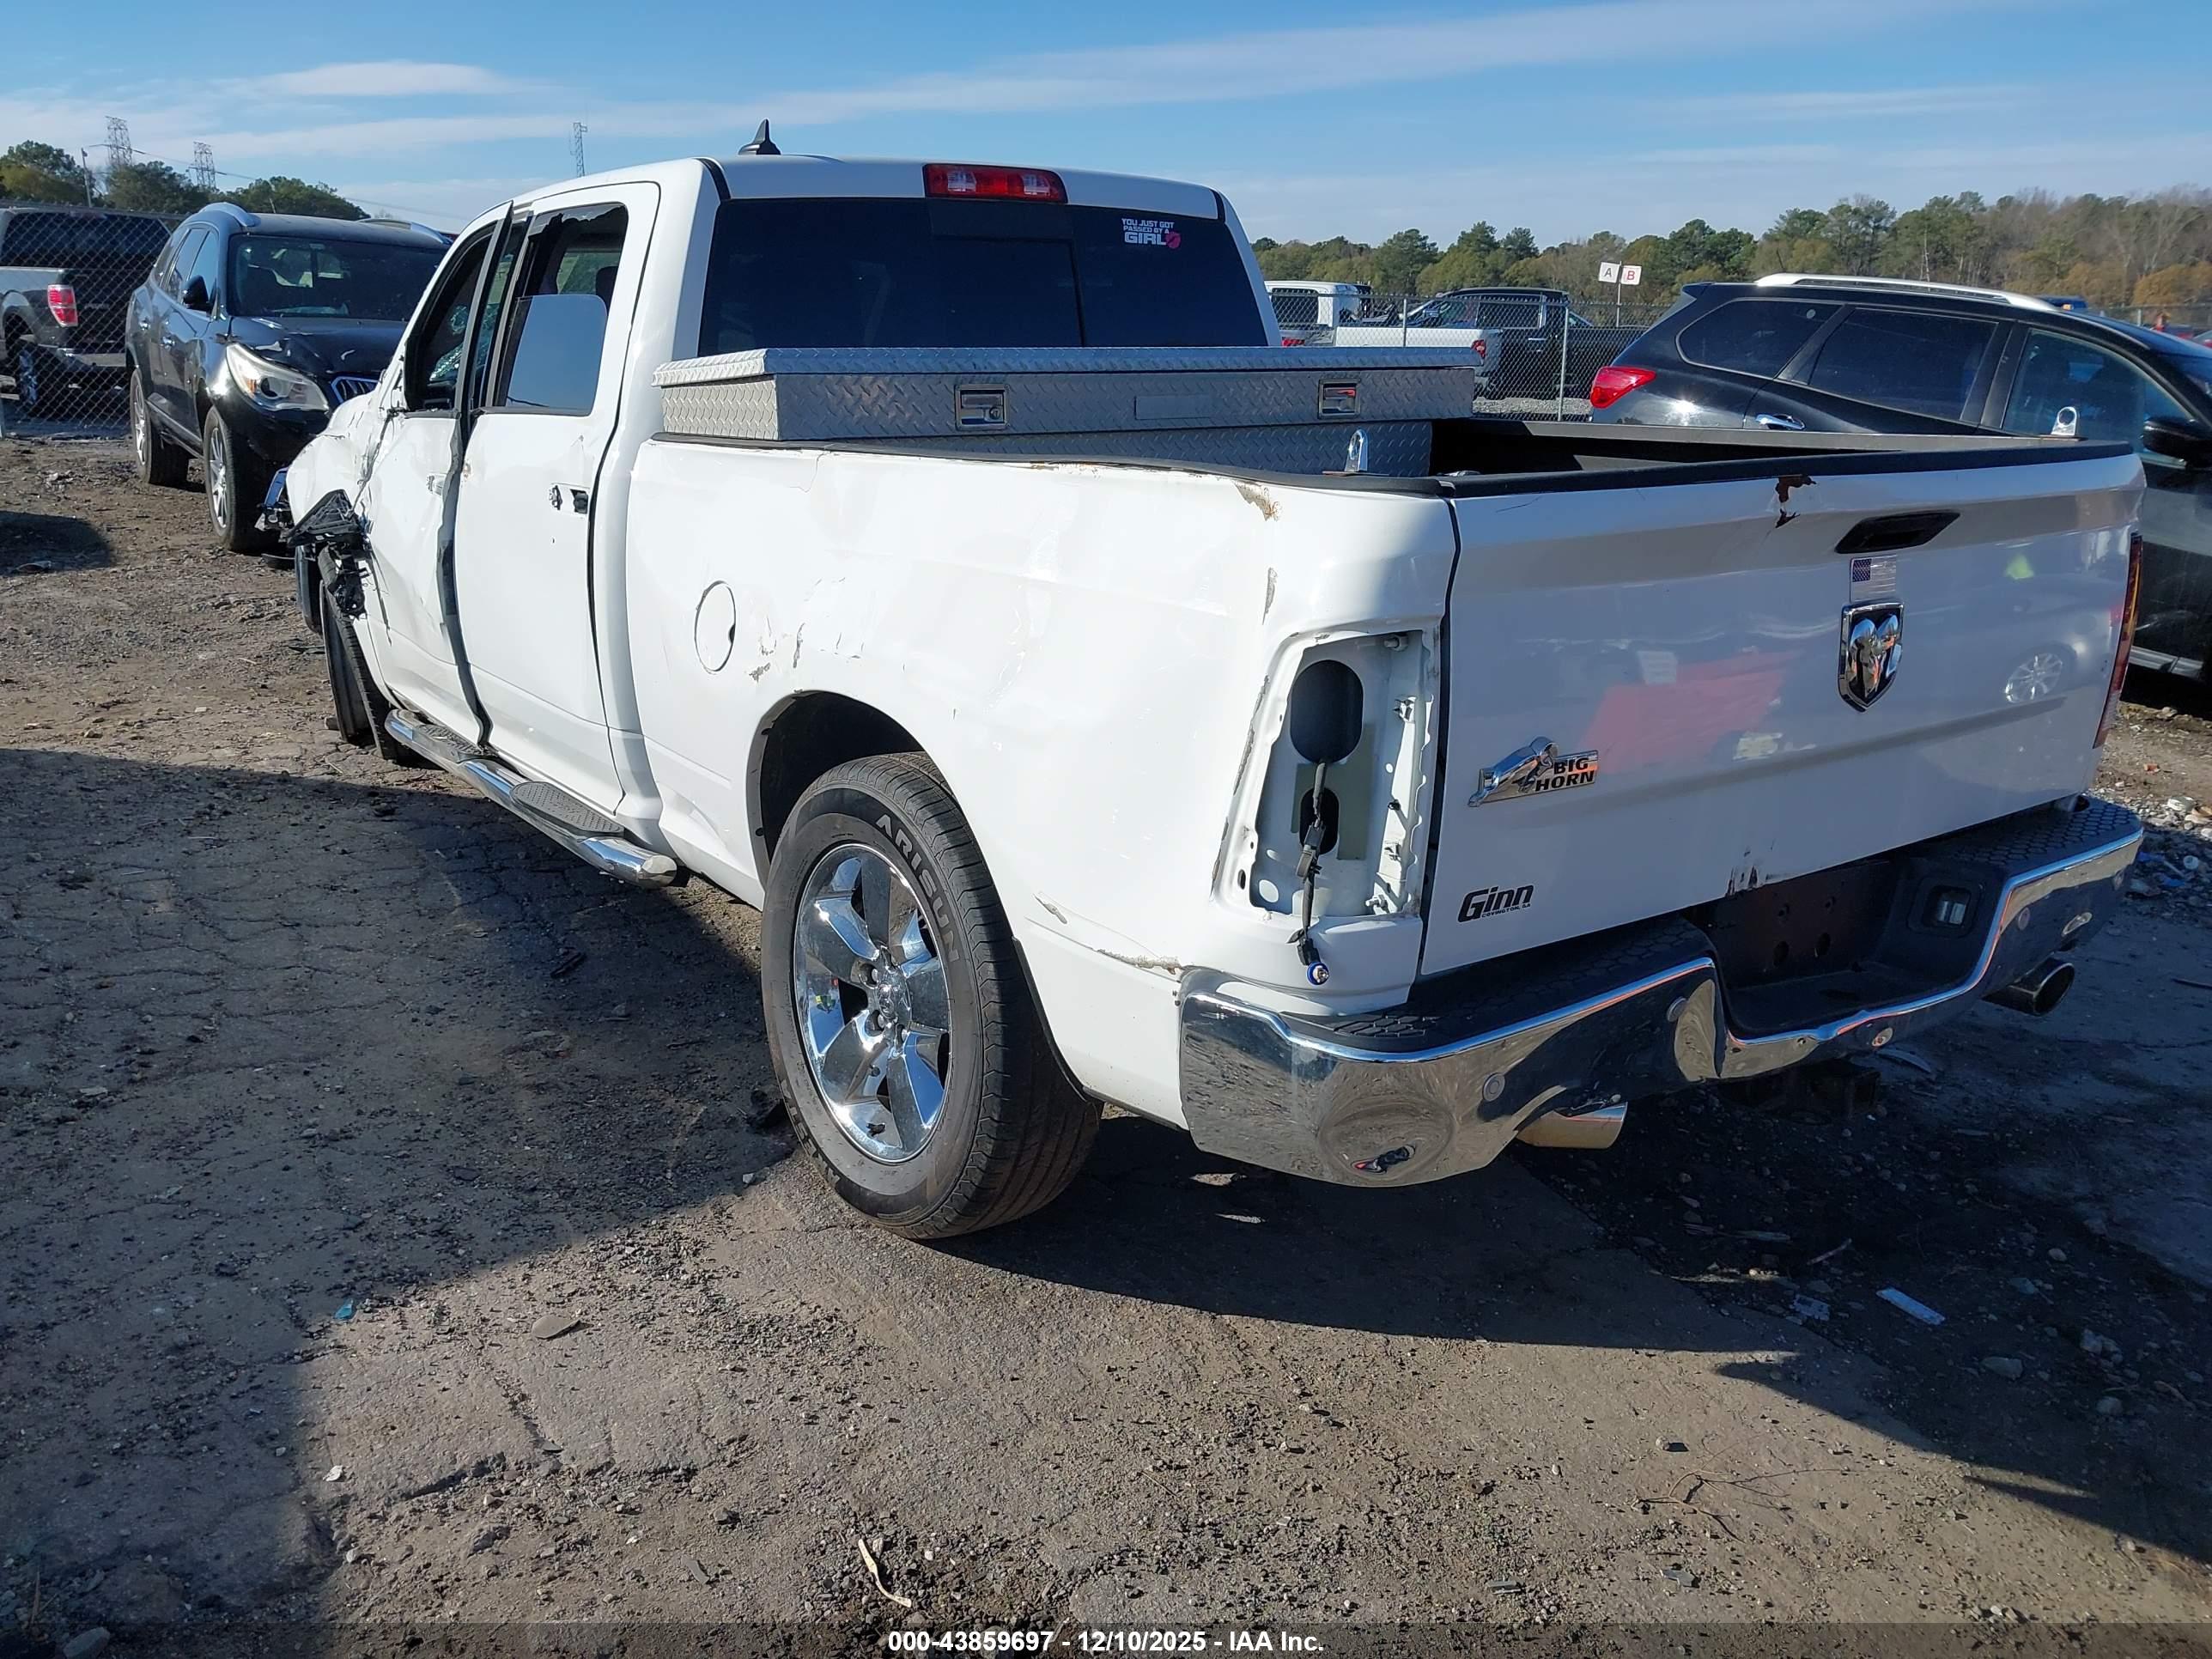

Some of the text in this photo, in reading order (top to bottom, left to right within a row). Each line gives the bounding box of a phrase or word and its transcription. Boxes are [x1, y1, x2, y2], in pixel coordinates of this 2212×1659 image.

[1121, 217, 1138, 226] YOU
[1124, 232, 1167, 246] GIRL
[1604, 267, 1612, 278] A
[1626, 270, 1636, 281] B
[1553, 757, 1589, 775] BIG
[1534, 771, 1595, 792] HORN
[875, 813, 960, 963] ARISUN
[1457, 884, 1534, 923] Ginn
